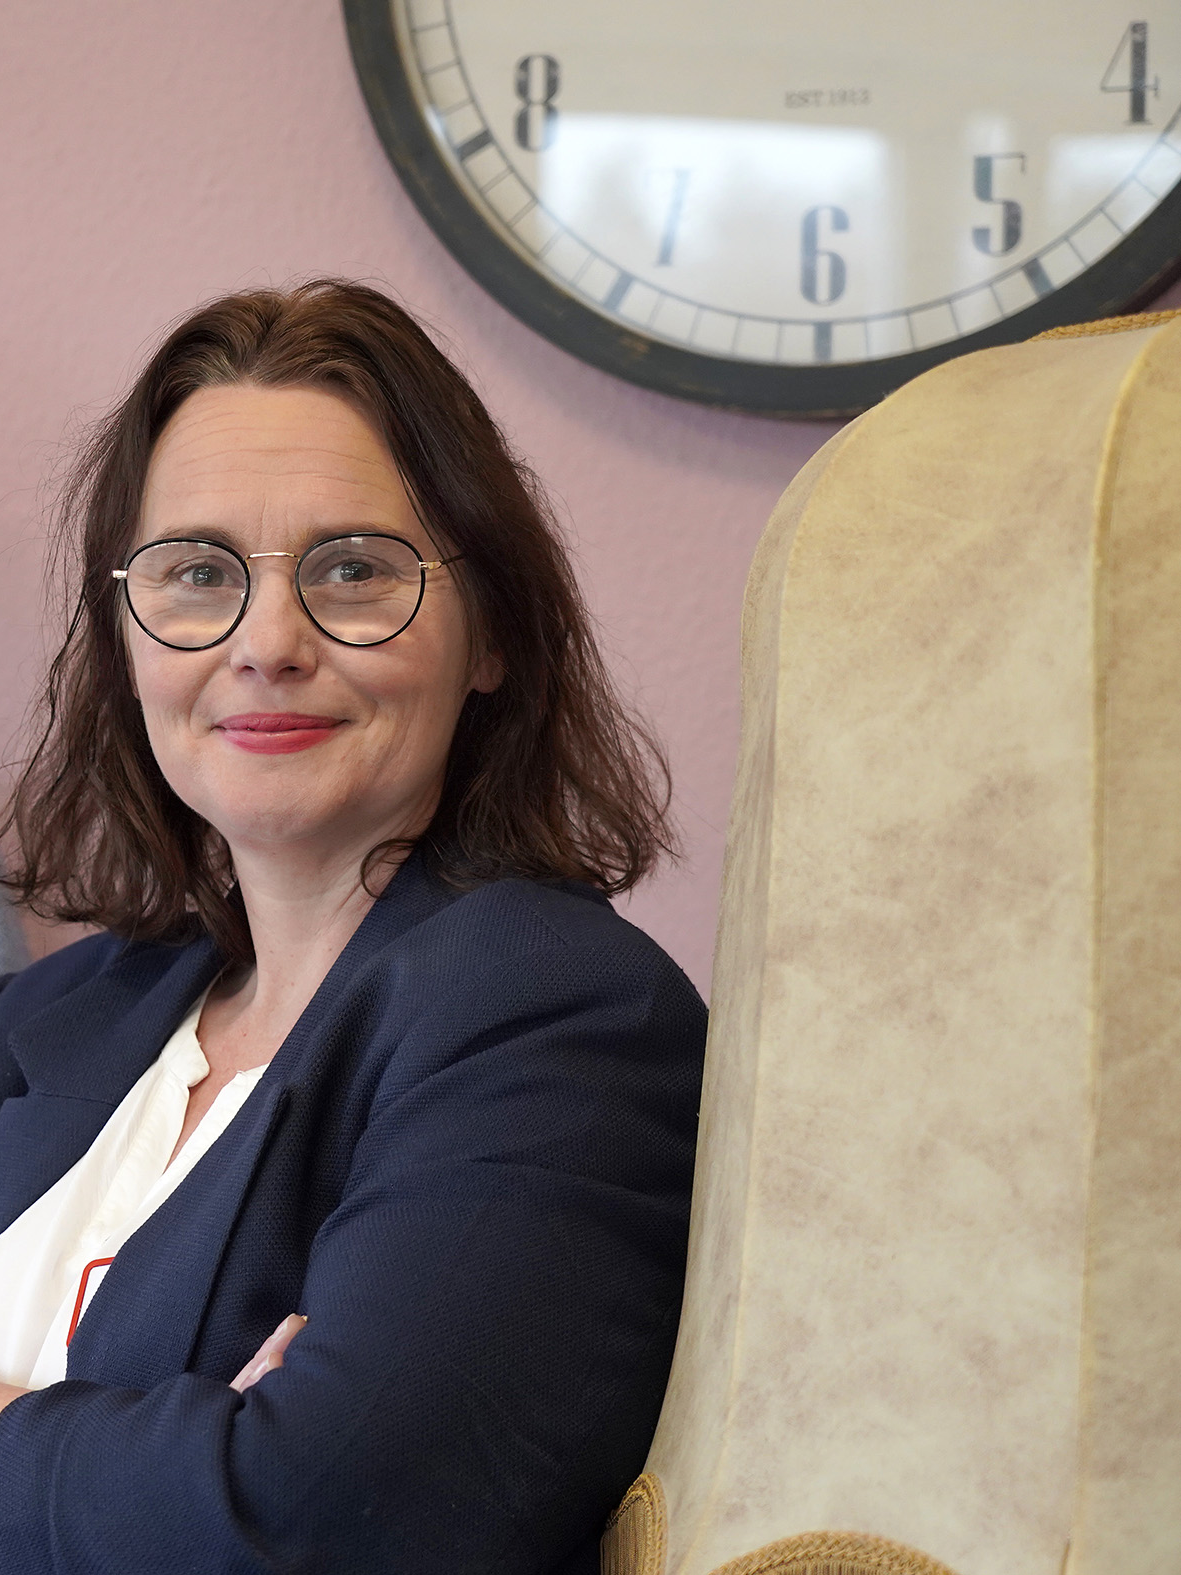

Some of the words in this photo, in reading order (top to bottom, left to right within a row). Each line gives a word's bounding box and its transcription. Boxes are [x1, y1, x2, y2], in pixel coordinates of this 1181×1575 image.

[514, 54, 561, 152] 8
[1100, 20, 1161, 126] 4
[642, 167, 692, 268] 7
[800, 203, 850, 306] 6
[971, 152, 1026, 257] 5
